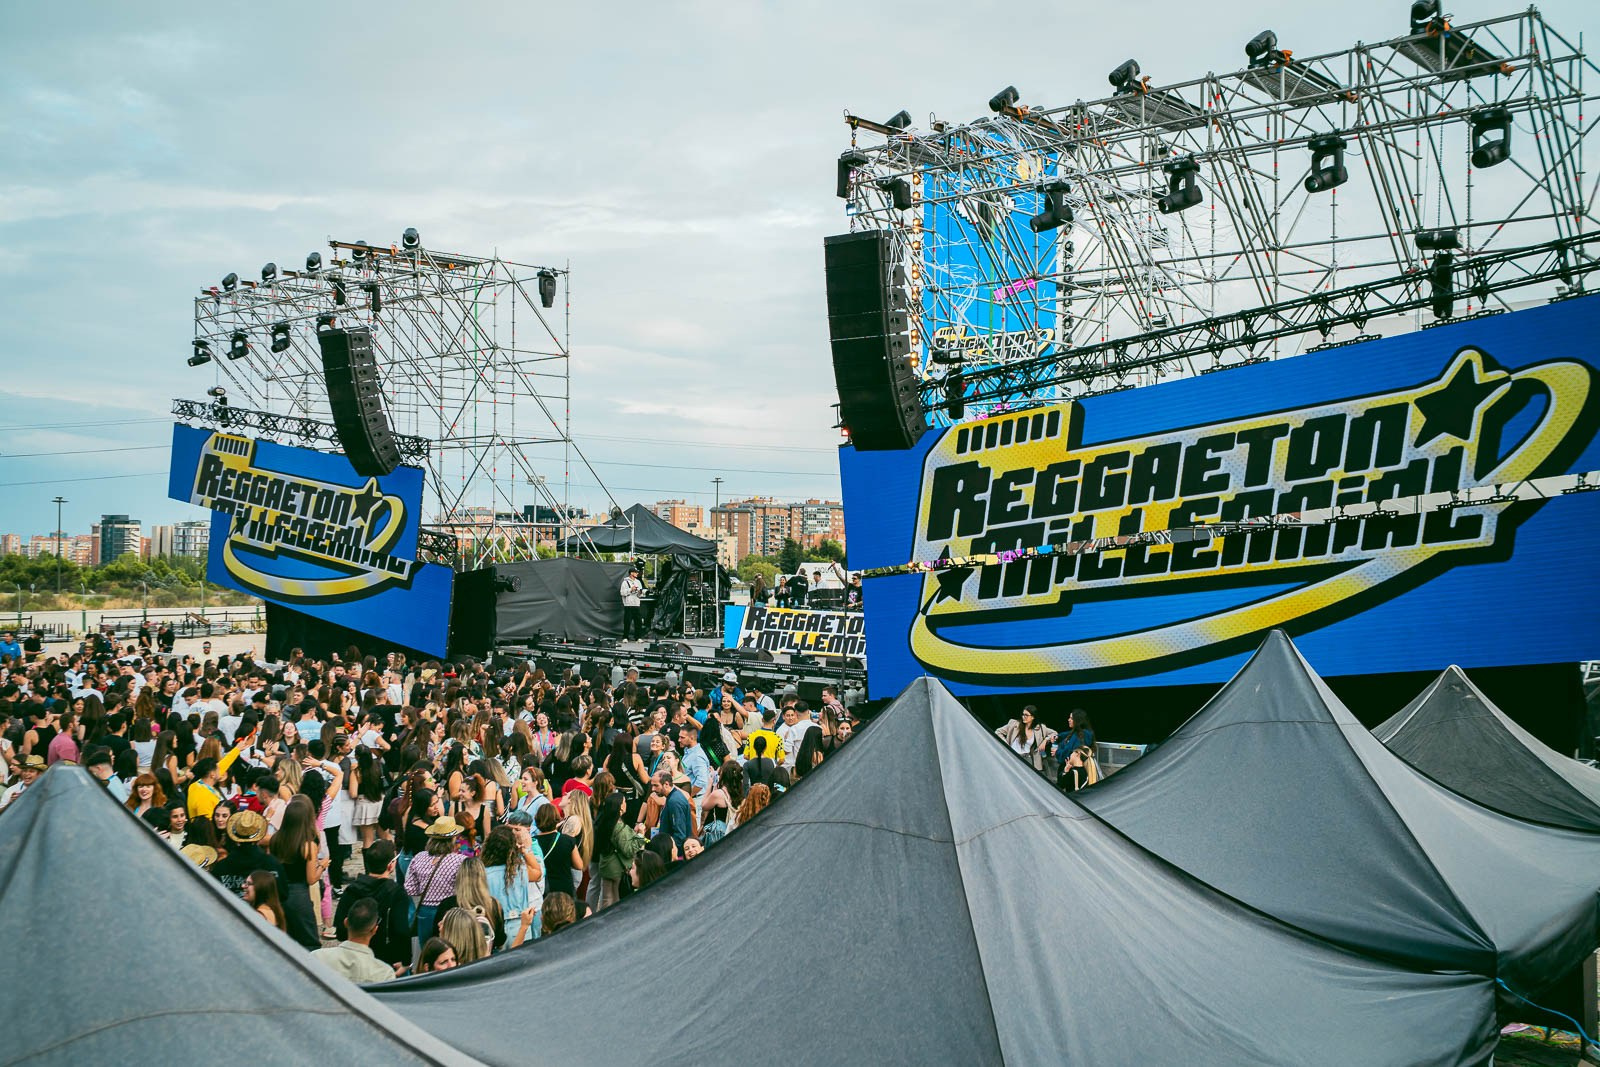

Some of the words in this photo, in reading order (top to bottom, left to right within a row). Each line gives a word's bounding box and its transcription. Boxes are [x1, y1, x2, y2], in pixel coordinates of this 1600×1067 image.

[197, 453, 353, 526] REGGAETON
[927, 402, 1410, 541] REGGAETON
[745, 607, 864, 635] REGGAETO
